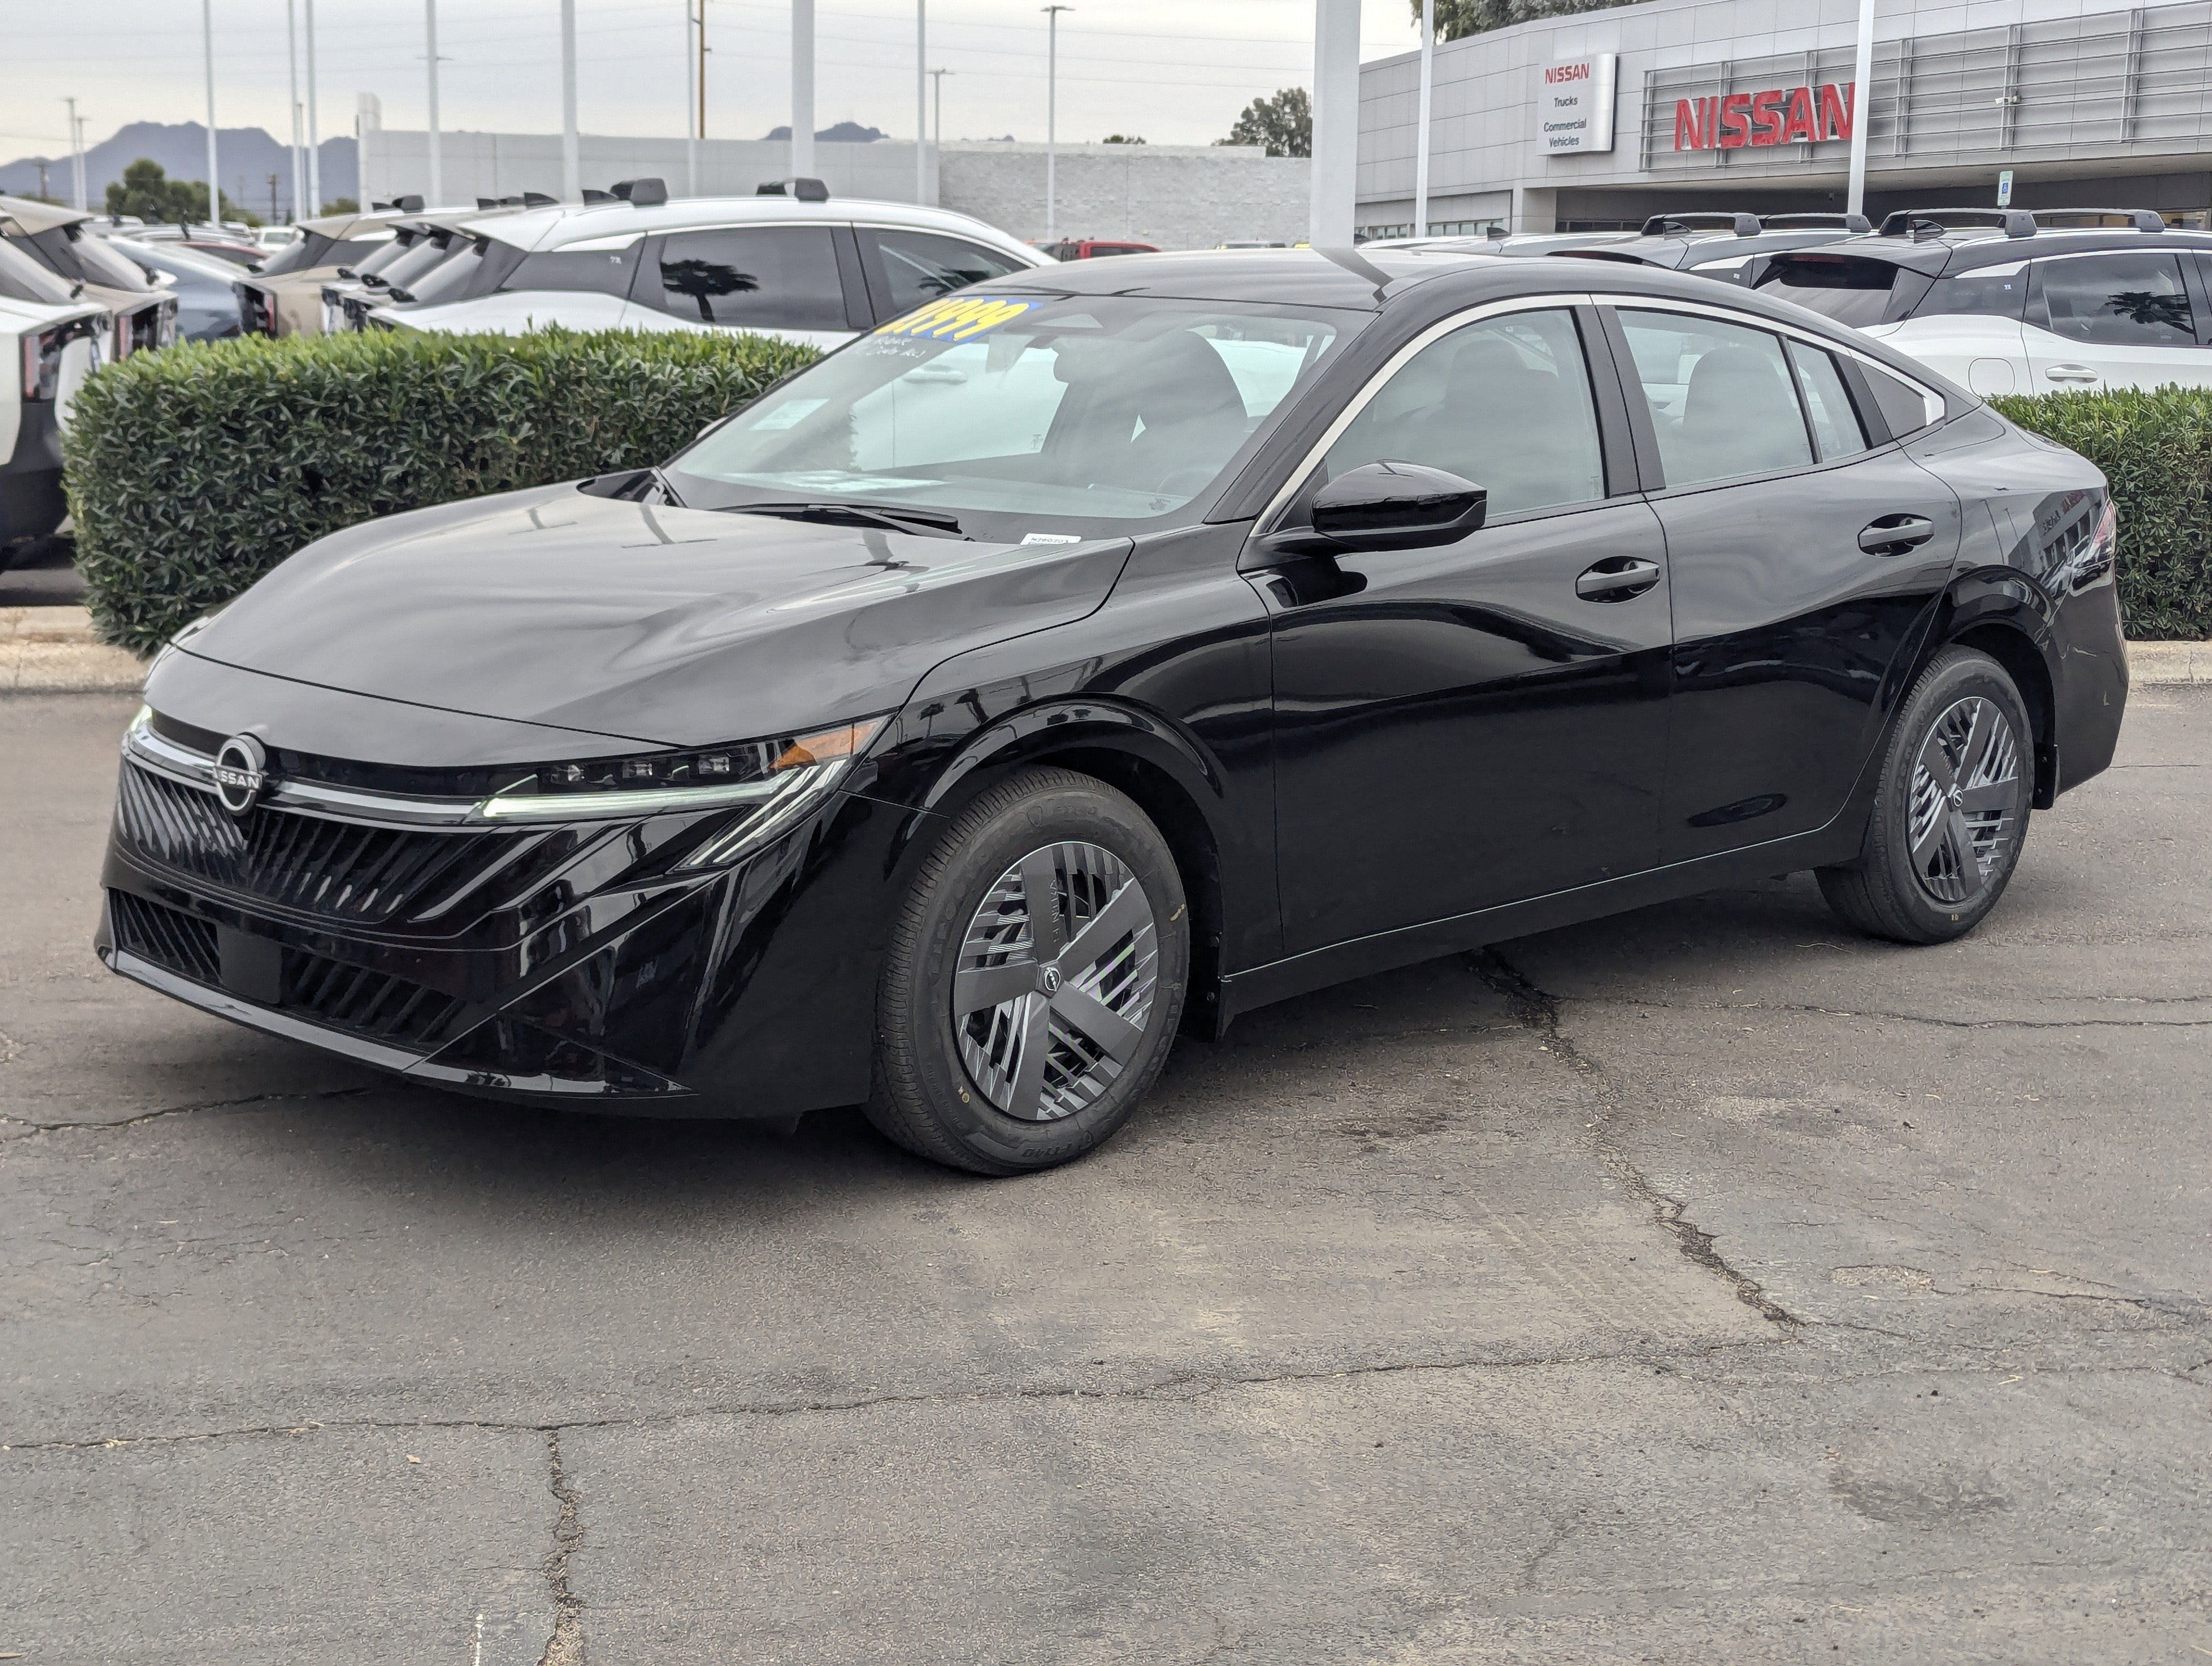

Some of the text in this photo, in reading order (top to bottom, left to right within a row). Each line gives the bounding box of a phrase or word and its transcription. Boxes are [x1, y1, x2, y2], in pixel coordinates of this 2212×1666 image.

[1545, 63, 1589, 85] NISSAN
[1554, 96, 1578, 108] Trucks
[1674, 82, 1856, 152] NISSAN
[1544, 118, 1587, 132] Commercial
[1548, 136, 1580, 148] Vehicles
